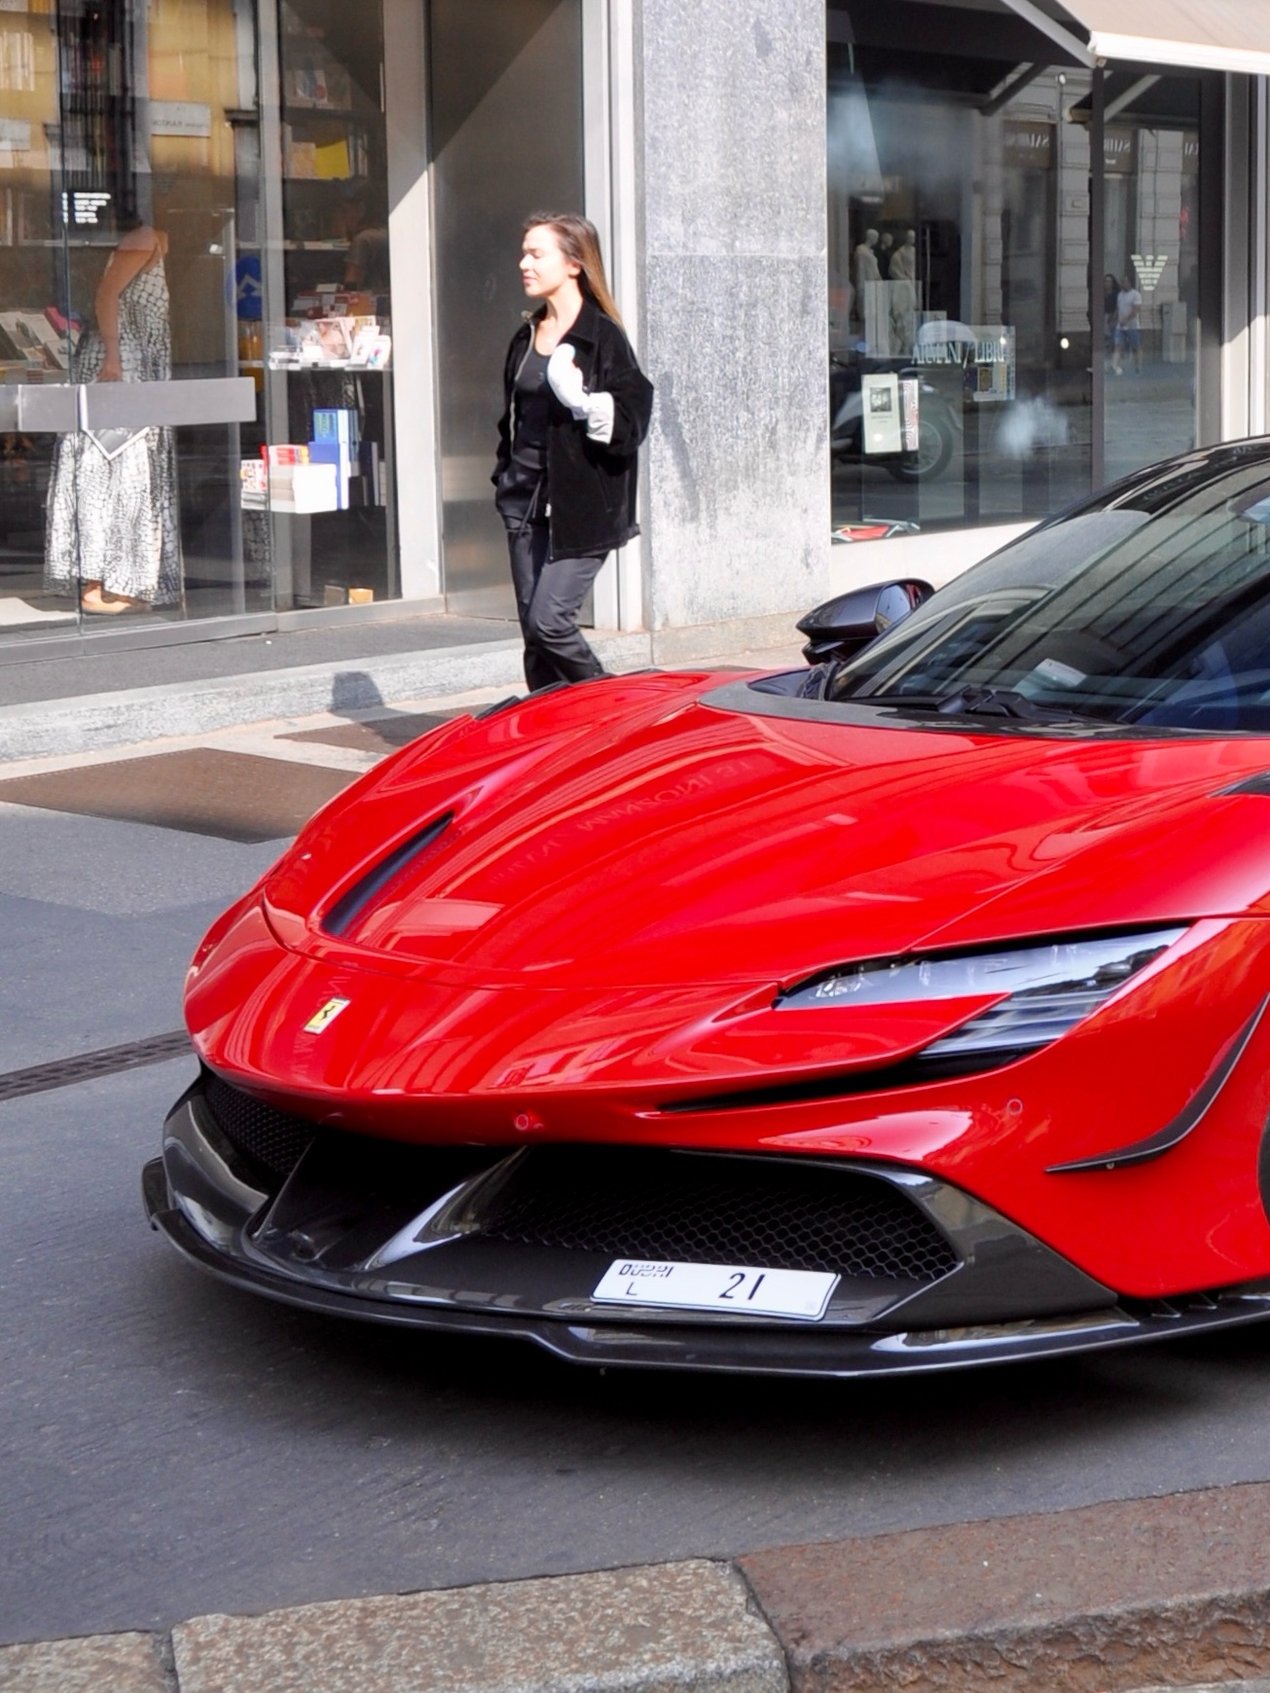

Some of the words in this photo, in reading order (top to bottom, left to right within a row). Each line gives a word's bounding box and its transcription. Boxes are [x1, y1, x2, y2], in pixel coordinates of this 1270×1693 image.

[911, 342, 962, 365] ARMANI
[974, 341, 1006, 363] LIBRI
[625, 1281, 638, 1296] L
[718, 1272, 766, 1301] 21
